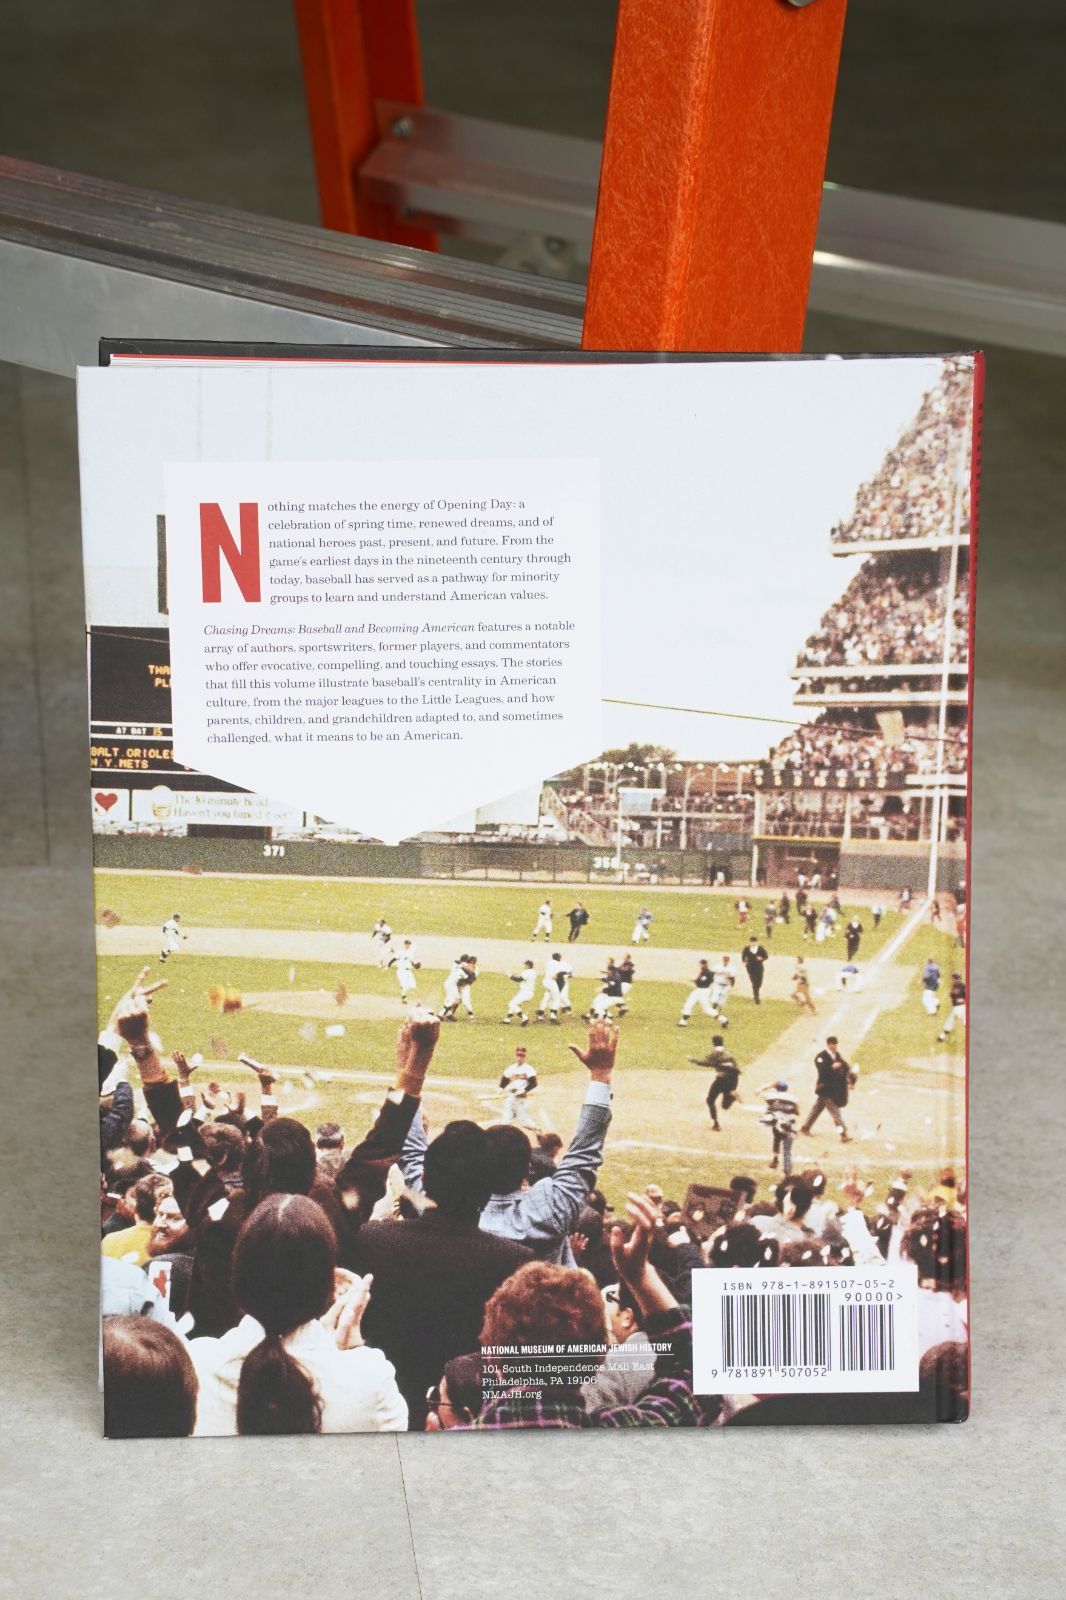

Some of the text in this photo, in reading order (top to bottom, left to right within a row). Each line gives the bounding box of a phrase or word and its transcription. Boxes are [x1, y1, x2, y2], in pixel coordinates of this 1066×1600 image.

[267, 498, 526, 514] othing matches the energy of Opening Day: a
[267, 516, 555, 532] celebration of spring time, renewed dreams, and of
[268, 534, 554, 550] national heroes past, present, and future. From the
[269, 552, 572, 569] game's earliest days in the nineteenth century through
[269, 571, 561, 587] today, baseball has served as a pathway for minority
[270, 589, 549, 606] groups to learn and understand American values.
[203, 620, 576, 637] Chasing Dreams: Baseball and Becoming American features a notable
[204, 639, 570, 656] array of authors, sportswriters, former players, and commentators
[204, 657, 563, 672] who offer evocative, compelling, and touching essays. The stories
[205, 675, 557, 690] that fill this volume illustrate baseball's centrality in American
[206, 692, 555, 709] culture, from the major leagues to the Little Leagues, and how
[206, 711, 564, 728] parents, children, and grandchildren adapted to, and sometimes
[116, 727, 127, 735] AT
[206, 730, 464, 745] challenged, what it means to be an American.
[723, 1279, 896, 1291] ISBN 978-1-891507-05-2
[481, 1342, 673, 1356] NATIONAL MUSEUM OF AMERICAN JEWISH HISTORY
[482, 1362, 655, 1374] 101 South Independence Mall East
[711, 1368, 828, 1379] 9 781891 507052
[482, 1375, 598, 1387] Philadelphia, PA 19106
[482, 1390, 543, 1401] NMAJH.org
